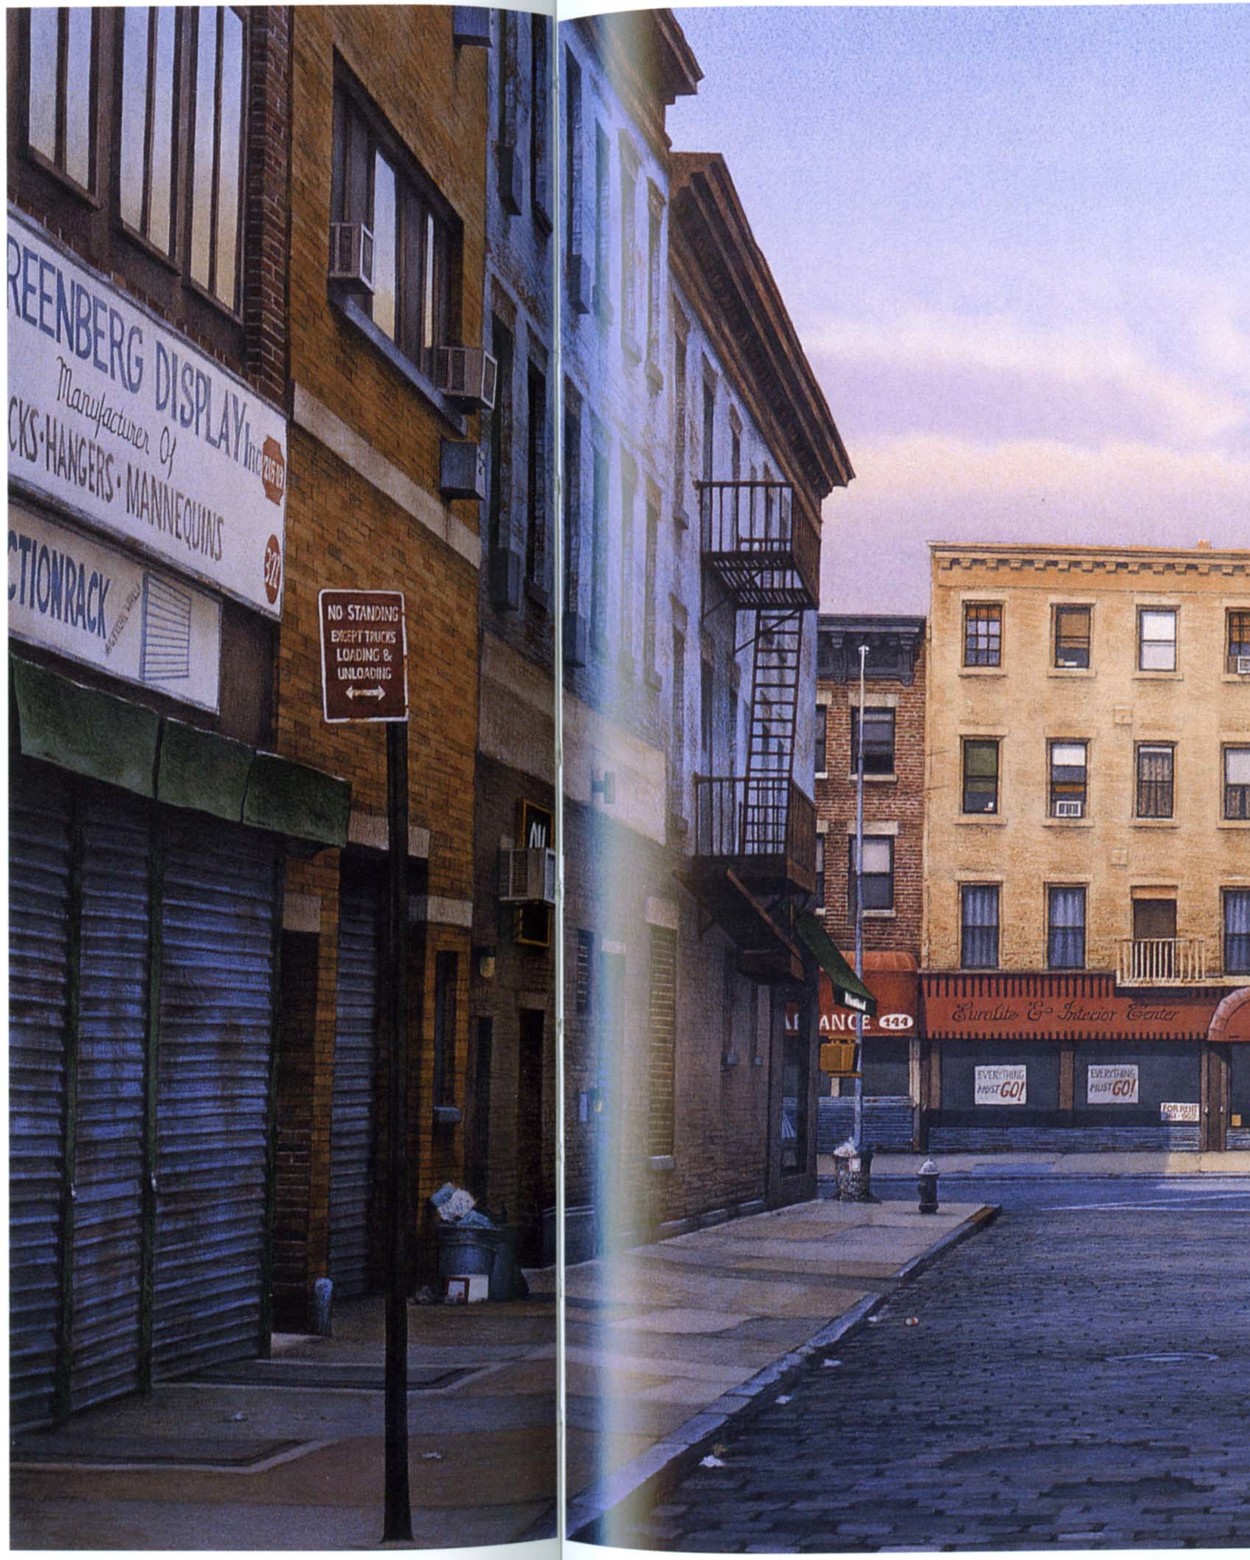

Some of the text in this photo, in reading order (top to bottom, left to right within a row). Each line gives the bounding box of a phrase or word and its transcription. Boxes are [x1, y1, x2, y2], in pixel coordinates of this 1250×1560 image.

[56, 356, 150, 454] Manufacturer
[156, 340, 248, 463] DISPLAY
[46, 413, 114, 503] HANGERS
[126, 462, 225, 561] MANNEQUINS
[327, 604, 399, 622] NO STANDING
[330, 630, 396, 643] EXCEPT TRUCKS
[336, 648, 392, 662] LOADING &
[337, 667, 392, 680] UNLOADING
[1058, 1000, 1118, 1022] Interior
[1126, 1001, 1180, 1022] Center
[977, 1069, 1025, 1080] EVERYTHING
[1090, 1068, 1136, 1079] EVERYTHING
[977, 1081, 1025, 1101] MUST GO!
[1090, 1079, 1136, 1097] MUST GO!
[1163, 1104, 1178, 1112] FOR
